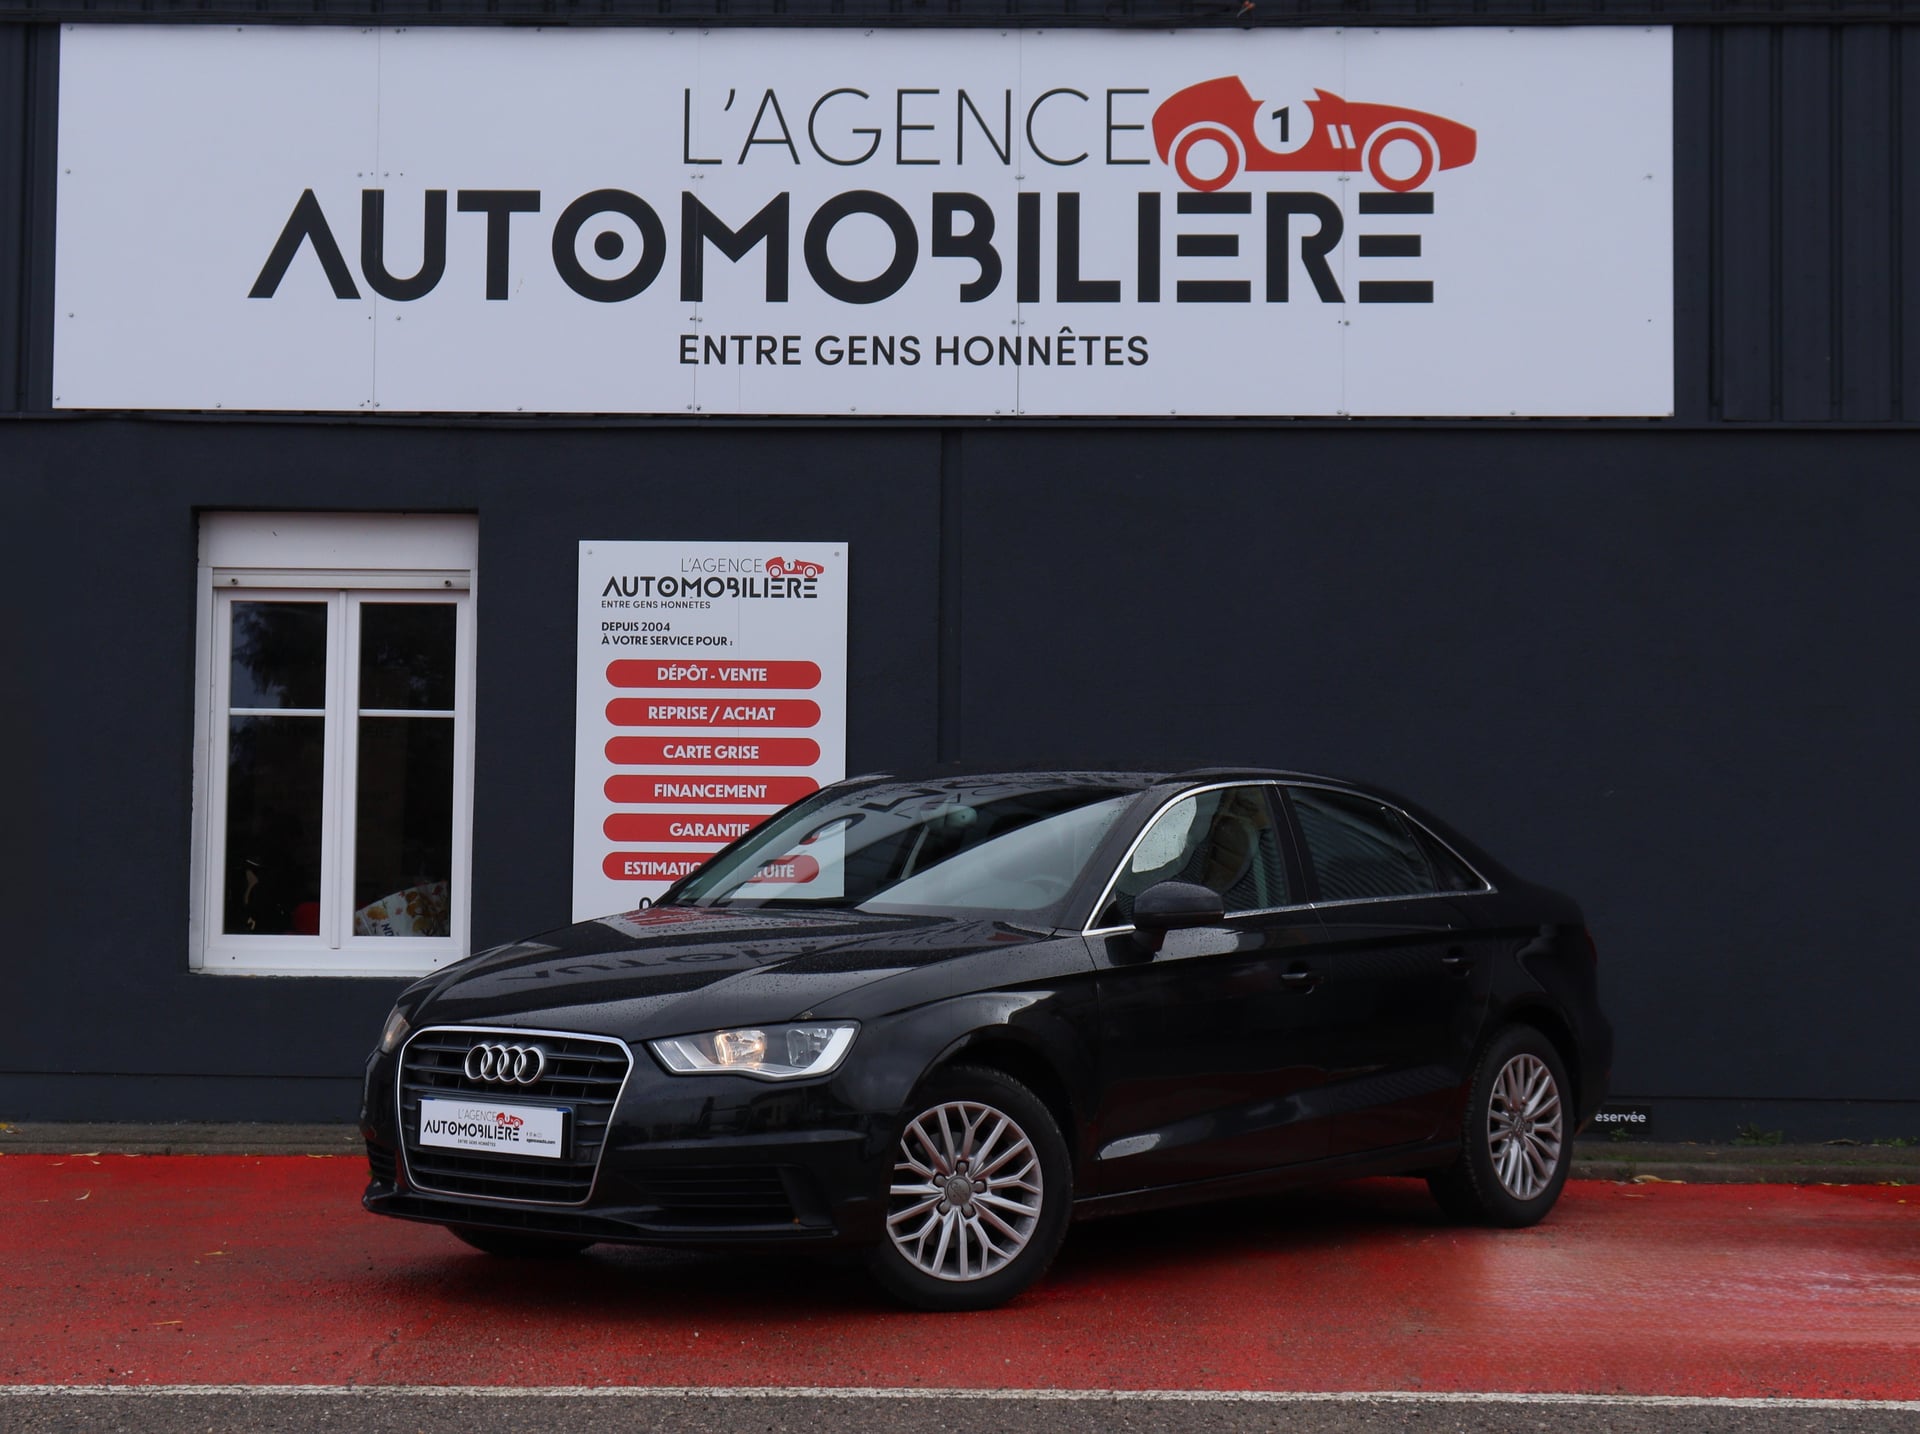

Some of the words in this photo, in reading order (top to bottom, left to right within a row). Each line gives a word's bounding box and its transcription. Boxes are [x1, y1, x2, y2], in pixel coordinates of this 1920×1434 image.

[683, 87, 1151, 167] L'AGENCE
[247, 188, 1434, 304] AUTOMOBILIERE
[679, 334, 802, 365] ENTRE
[814, 335, 921, 366] GENS
[935, 326, 1149, 366] HONNÊTES
[681, 557, 763, 573] L'AGENCE
[602, 576, 818, 599] AUTOMOBILIERE
[601, 600, 631, 609] ENTRE
[632, 600, 658, 609] GENS
[601, 621, 639, 632] DEPUIS
[641, 621, 671, 632] 2004
[601, 632, 610, 645] À
[611, 635, 648, 646] VOTRE
[650, 635, 694, 646] SERVICE
[696, 636, 728, 646] POUR
[657, 663, 708, 682] DÉPÔT
[718, 667, 768, 682] VENTE
[648, 705, 708, 721] REPRISE
[722, 706, 776, 721] ACHAT
[662, 744, 712, 759] CARTE
[714, 745, 760, 760] GRISE
[654, 783, 768, 799] FINANCEMENT
[624, 861, 702, 876] ESTIMATI
